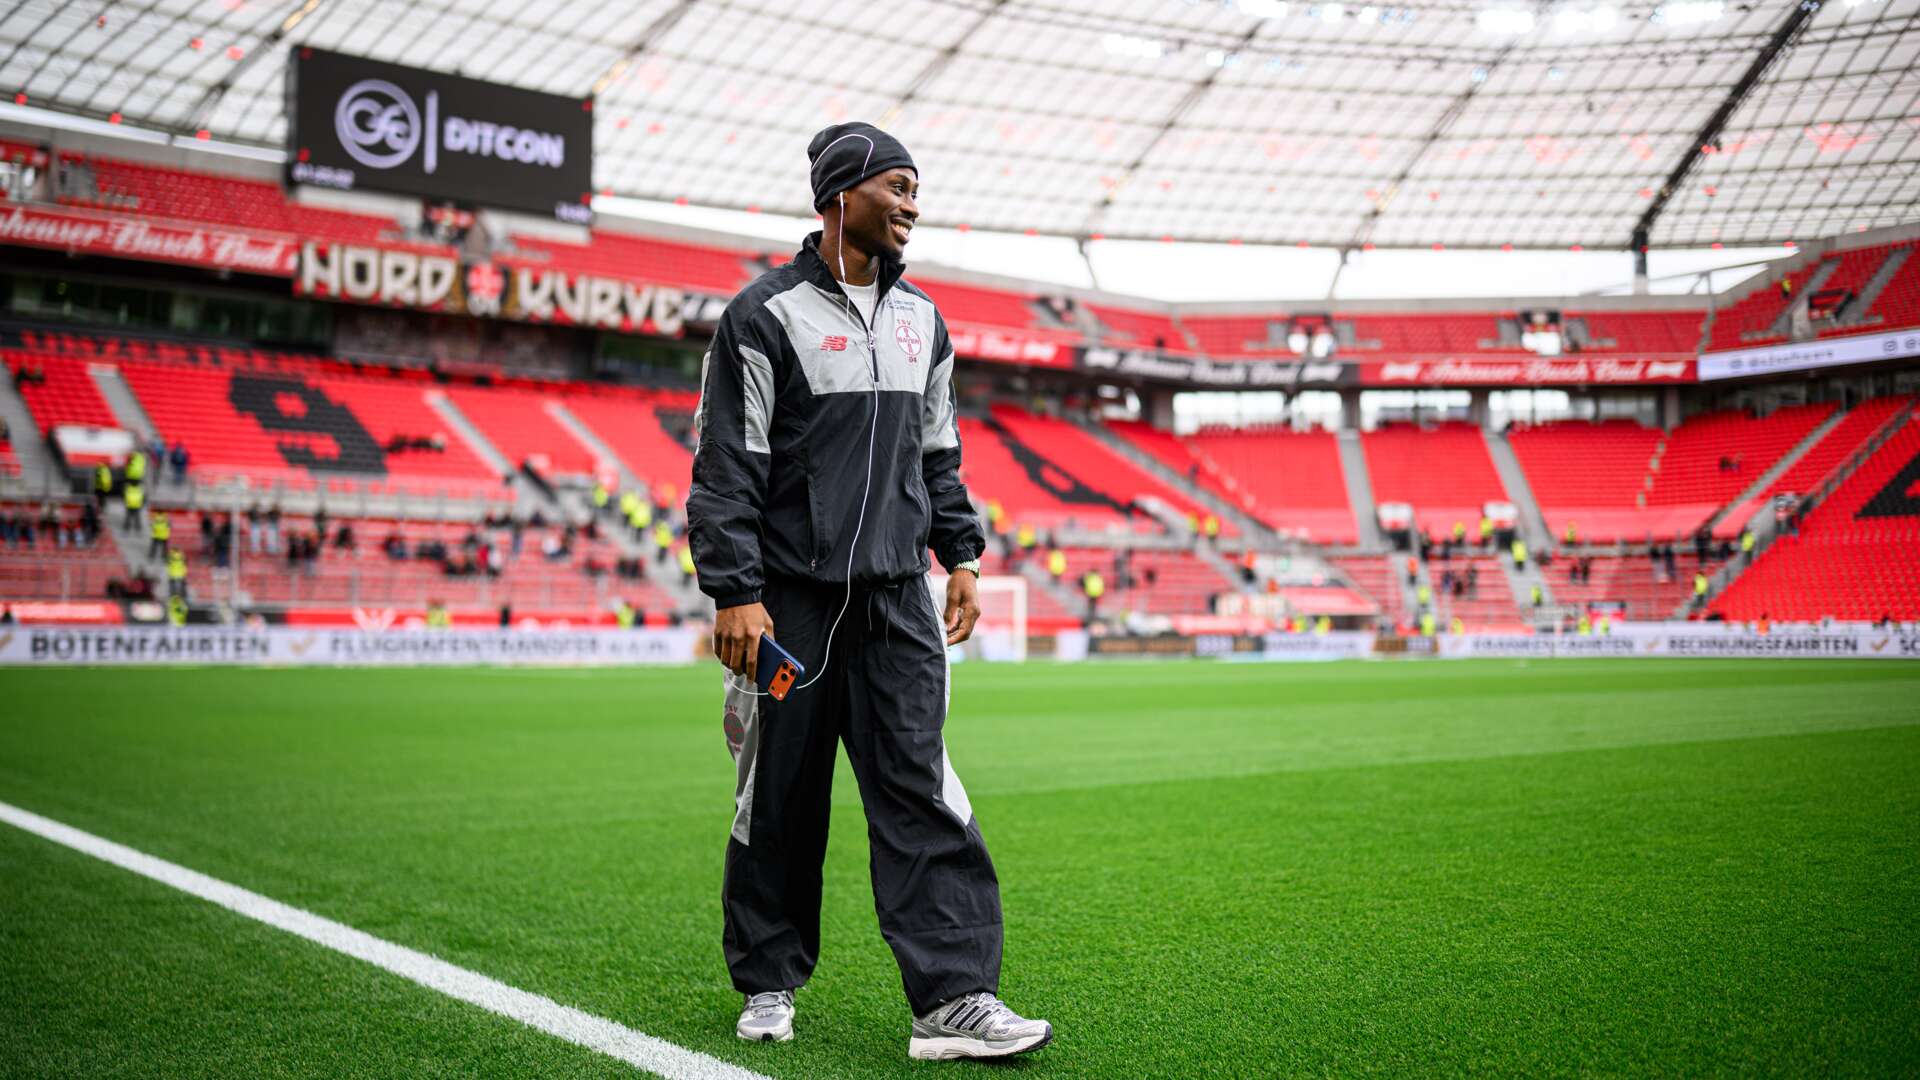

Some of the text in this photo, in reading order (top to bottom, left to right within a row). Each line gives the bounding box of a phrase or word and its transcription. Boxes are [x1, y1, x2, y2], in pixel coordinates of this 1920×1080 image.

[444, 116, 565, 168] DITCON
[302, 242, 458, 307] NORD
[517, 268, 684, 335] KURVE
